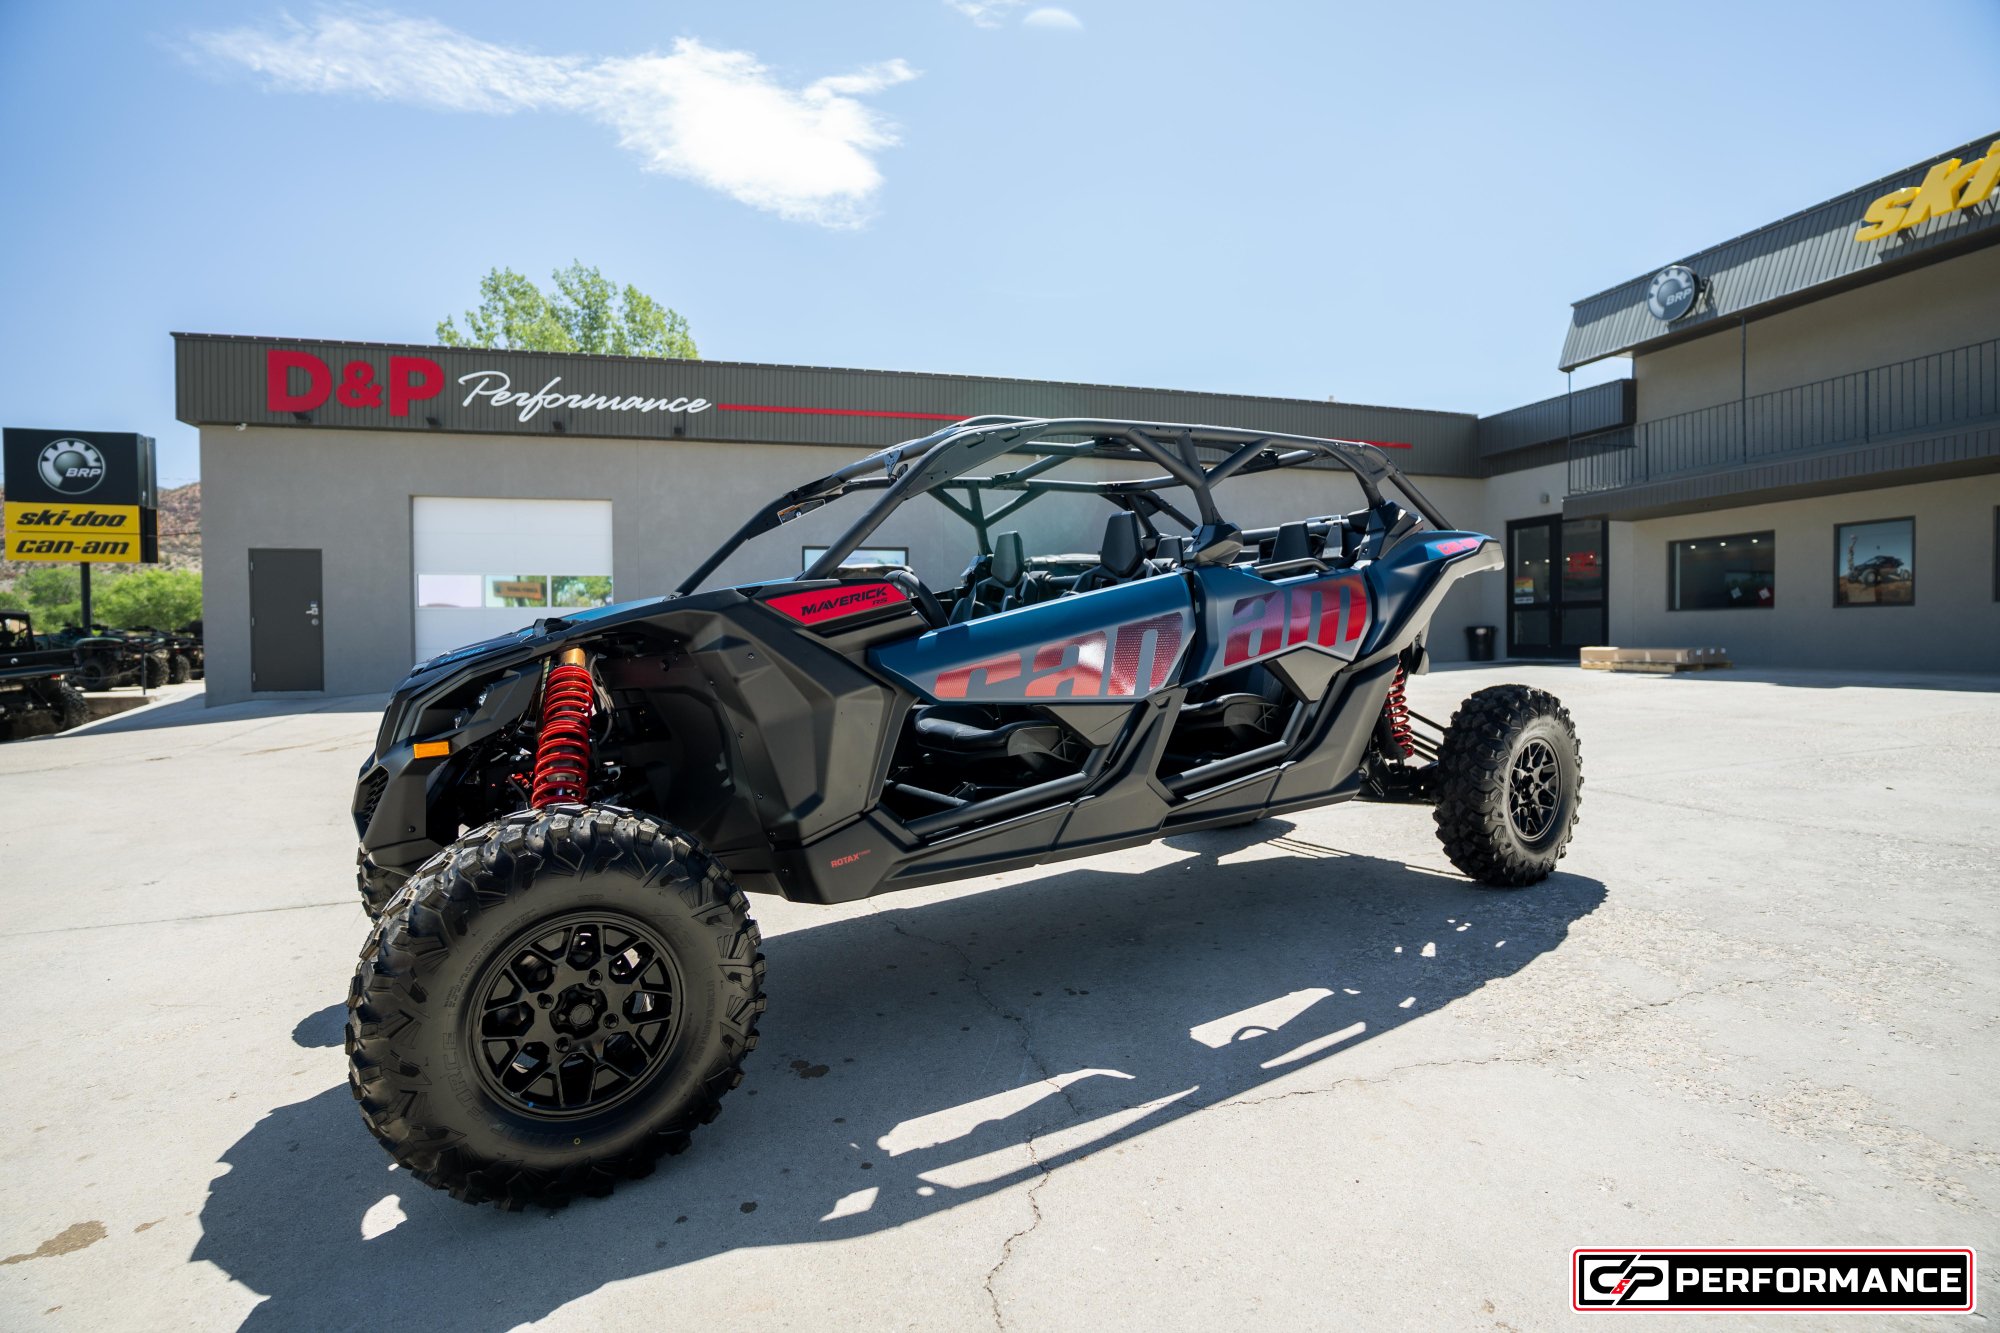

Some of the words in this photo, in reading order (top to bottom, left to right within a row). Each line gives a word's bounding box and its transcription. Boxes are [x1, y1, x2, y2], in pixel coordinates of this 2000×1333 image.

[1665, 287, 1692, 306] BRP
[266, 349, 446, 417] D&P
[458, 370, 712, 422] Performance
[65, 467, 102, 478] BRP
[16, 509, 127, 527] ski-doo
[16, 540, 130, 555] can-am
[801, 586, 887, 616] MAVERICK
[830, 852, 860, 868] ROTAX
